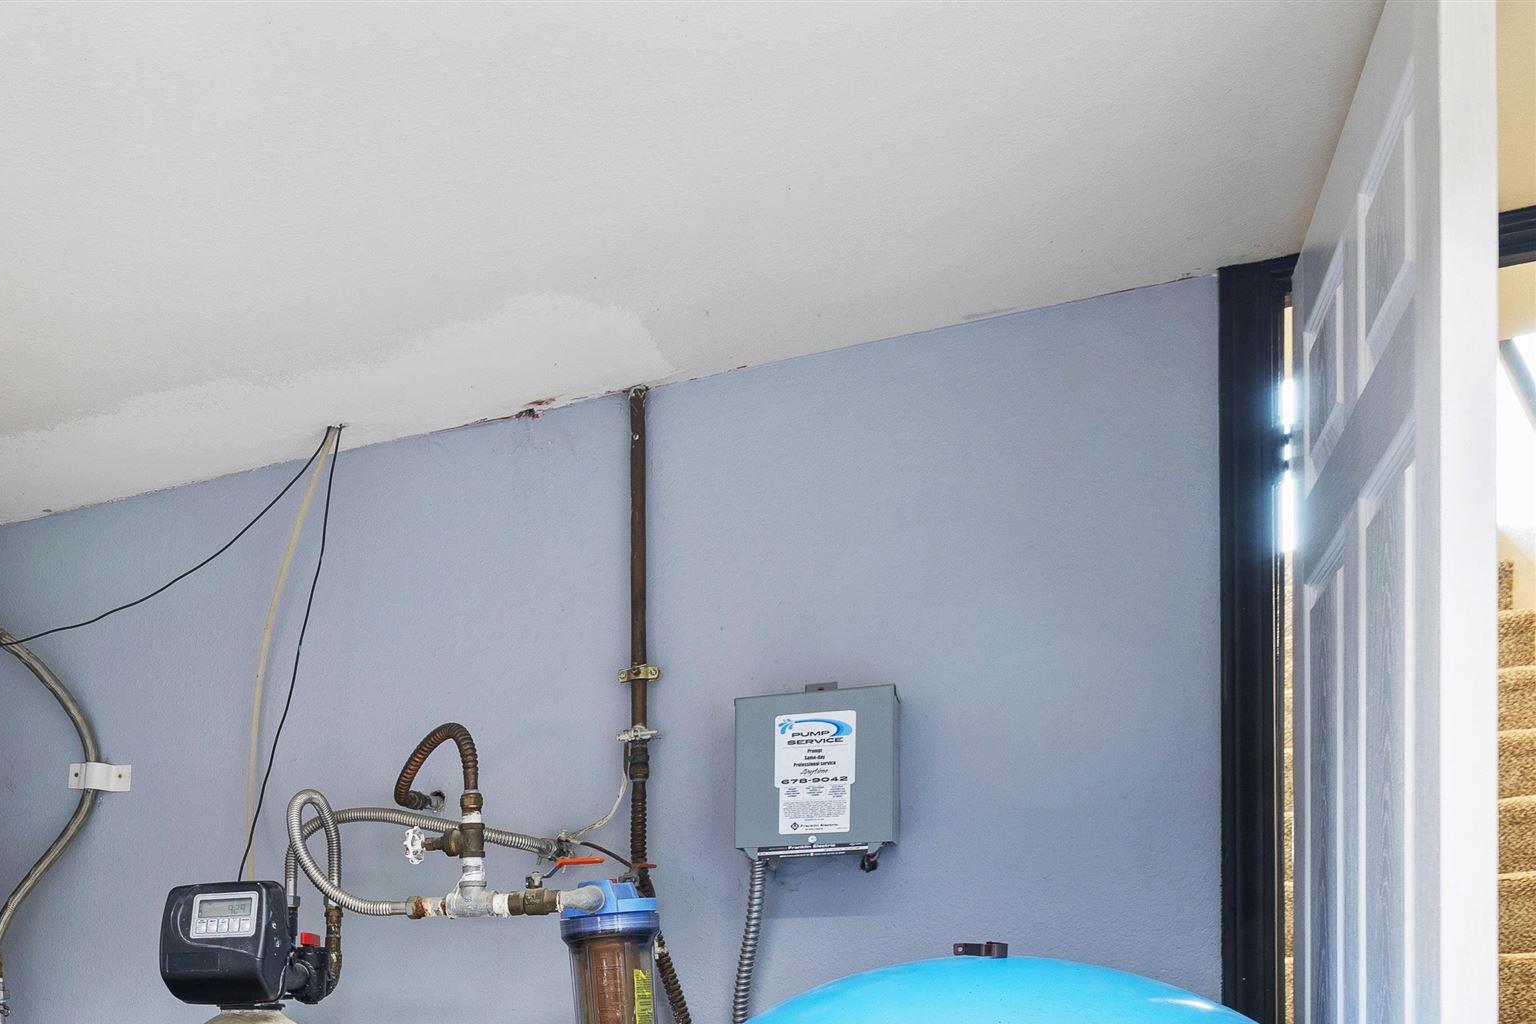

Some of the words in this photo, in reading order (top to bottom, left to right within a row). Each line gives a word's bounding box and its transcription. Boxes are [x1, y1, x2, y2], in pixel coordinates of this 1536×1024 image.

[791, 730, 830, 738] PUMP
[787, 737, 844, 746] SERVICE
[781, 776, 848, 785] 678-9042
